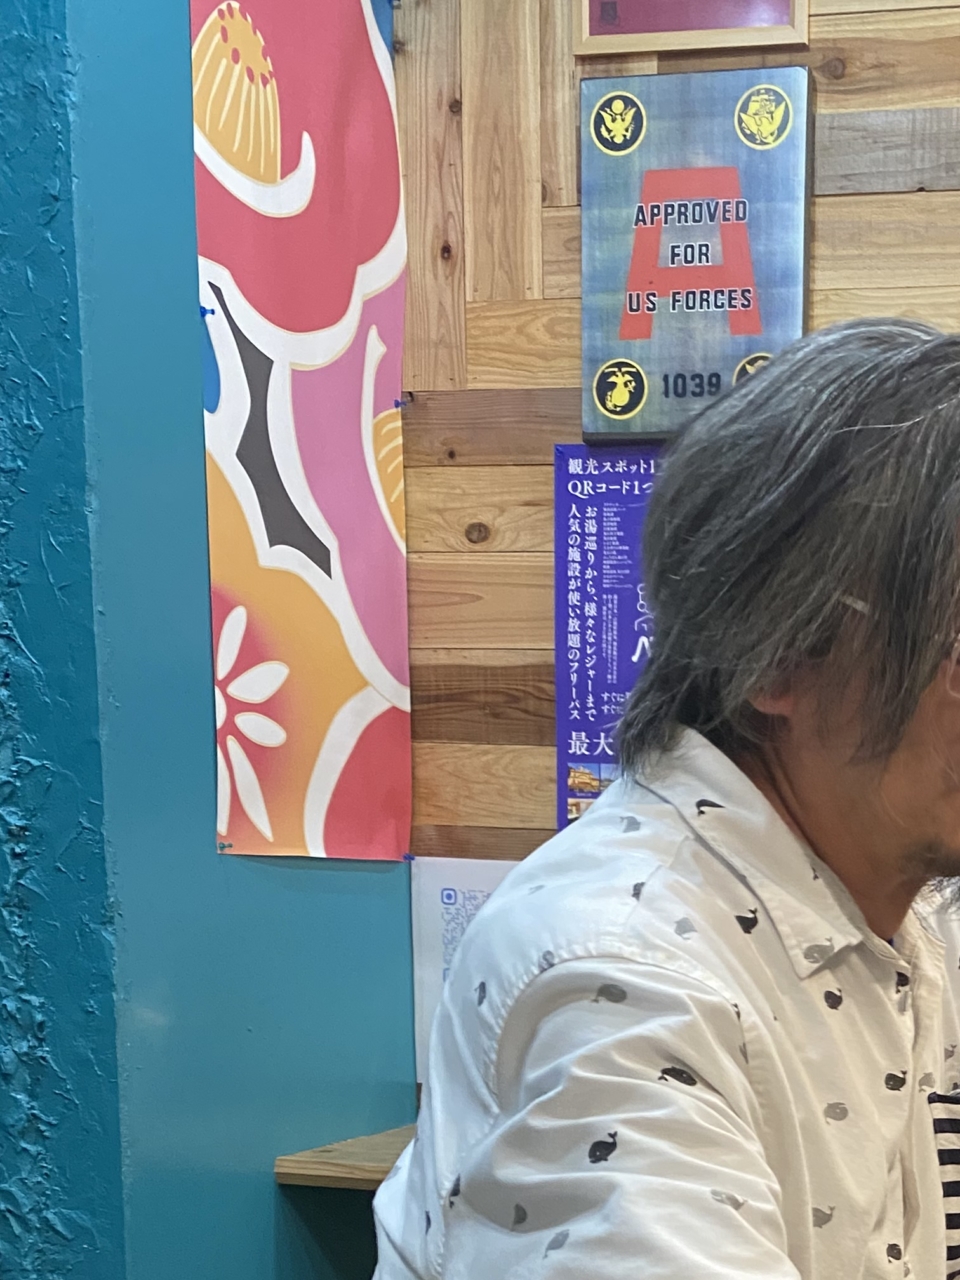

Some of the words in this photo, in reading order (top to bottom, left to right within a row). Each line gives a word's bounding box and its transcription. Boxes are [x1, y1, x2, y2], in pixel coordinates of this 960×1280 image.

[633, 199, 749, 228] APPROVED
[669, 243, 711, 267] FOR
[628, 291, 658, 314] US
[671, 288, 753, 313] FORCES
[662, 373, 722, 399] 1039
[567, 503, 581, 720] 人気の施設が使い放題のフリーパス
[568, 731, 614, 756] 最大
